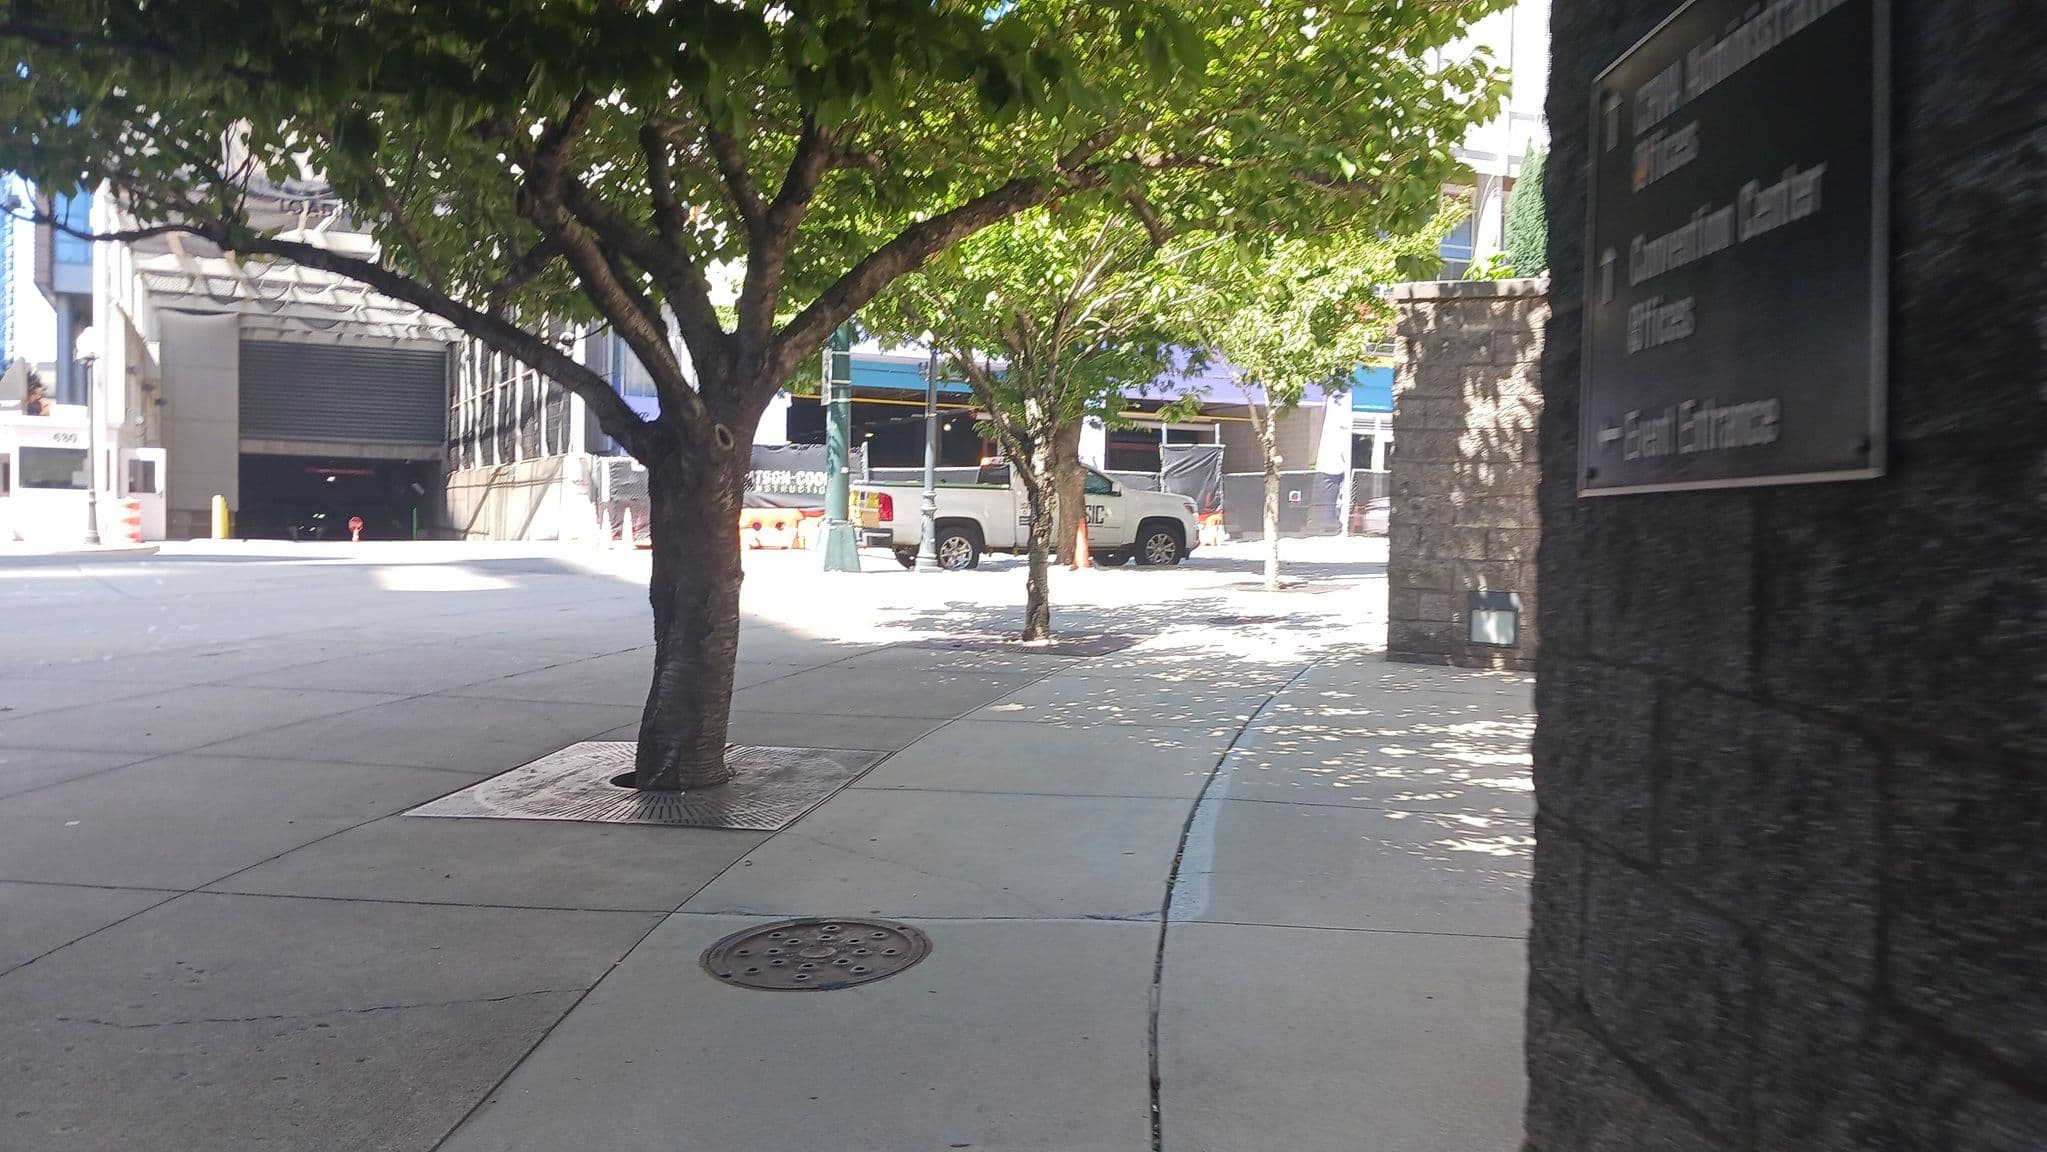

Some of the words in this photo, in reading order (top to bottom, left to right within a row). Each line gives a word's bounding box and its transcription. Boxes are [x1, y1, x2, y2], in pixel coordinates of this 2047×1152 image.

[1629, 202, 1735, 287] Convention
[1738, 162, 1828, 242] Center
[1624, 404, 1678, 463] Event
[1679, 398, 1780, 454] Entrance
